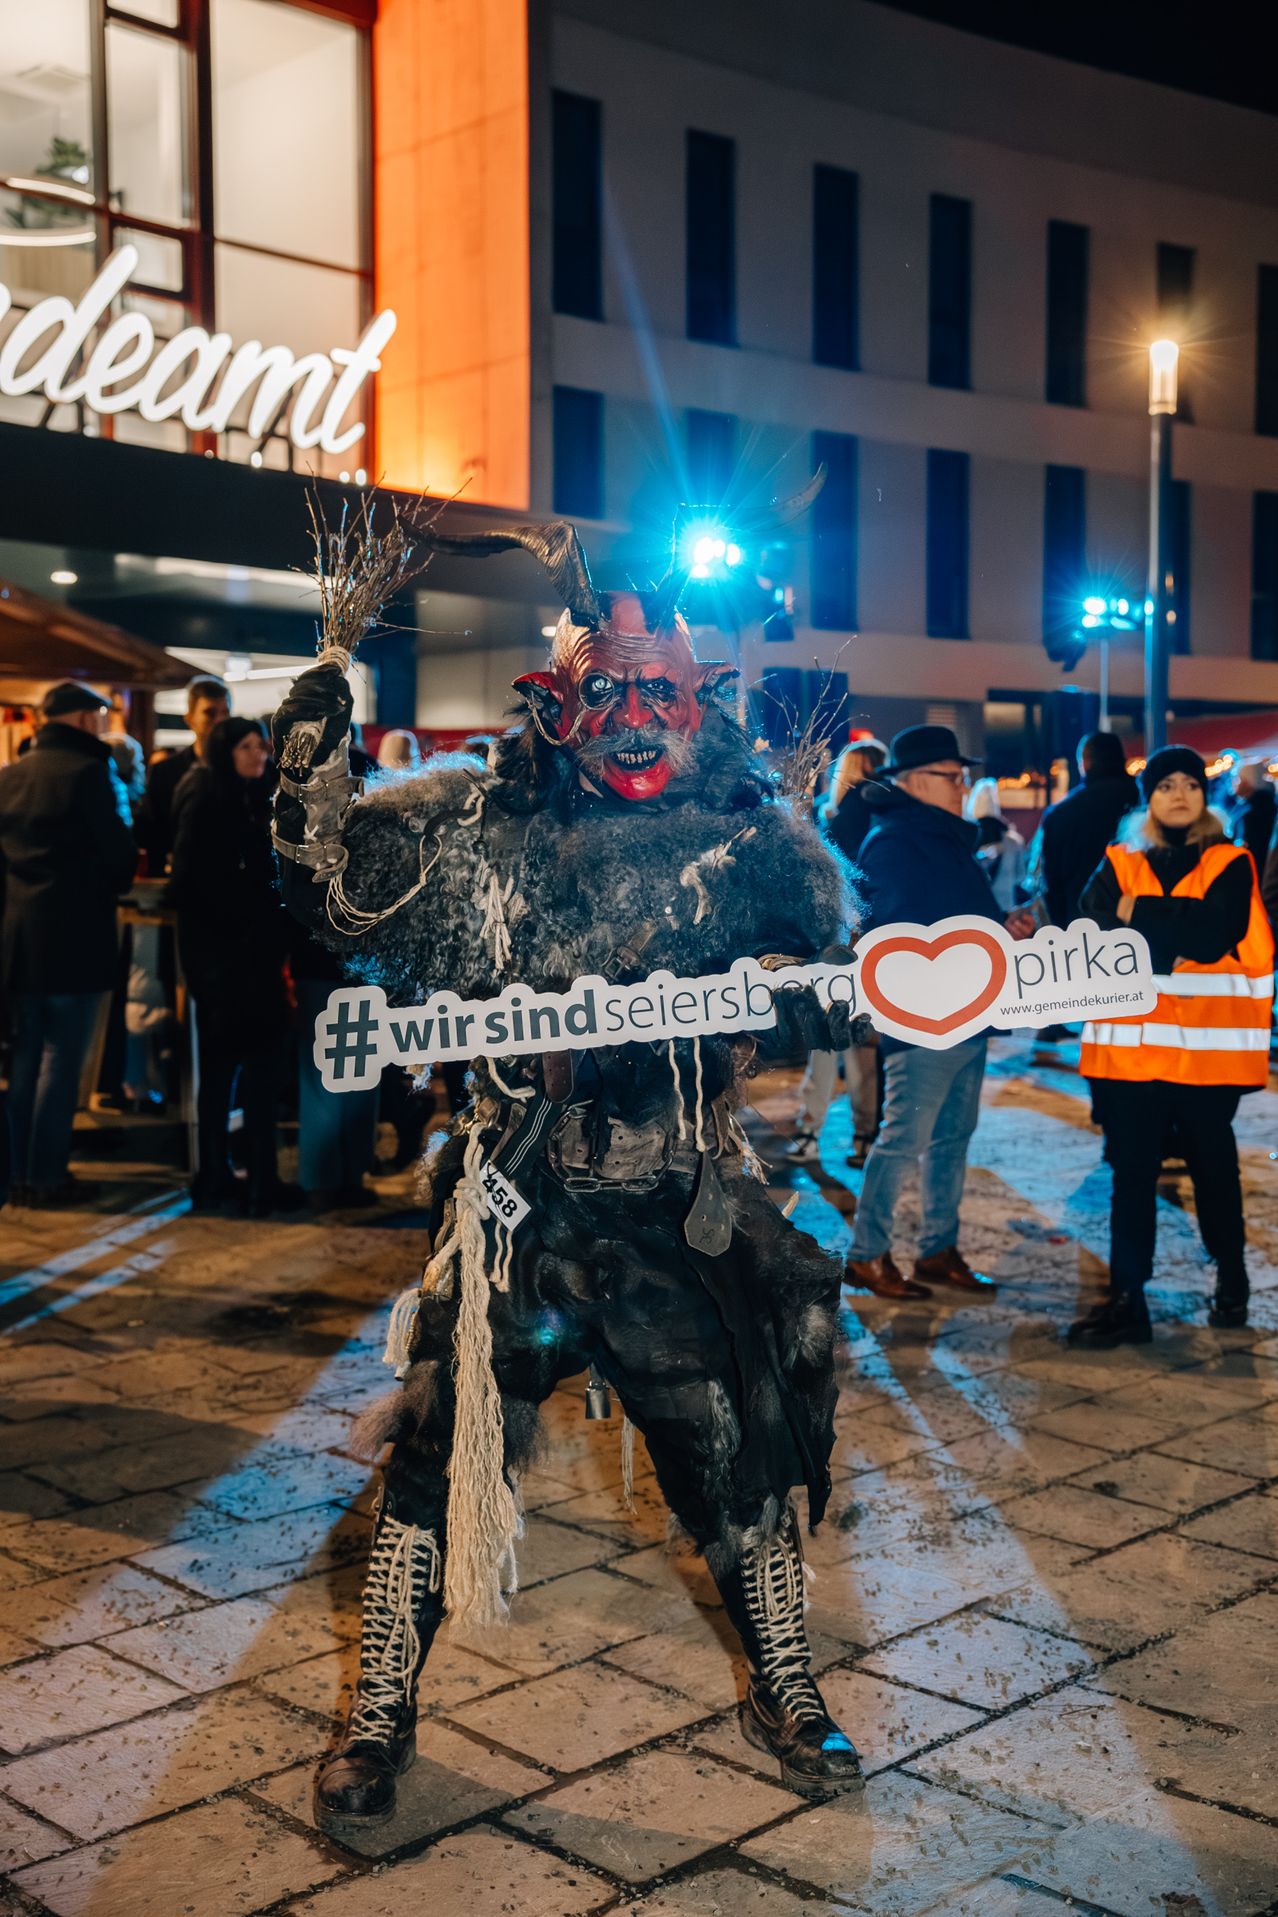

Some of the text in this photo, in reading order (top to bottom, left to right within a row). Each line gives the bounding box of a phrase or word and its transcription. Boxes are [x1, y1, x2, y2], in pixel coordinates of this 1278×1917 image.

[0, 244, 397, 454] deamt
[1014, 932, 1139, 1000] pirka
[1000, 991, 1144, 1016] www.gemeindekurier.at
[482, 1178, 518, 1218] 458
